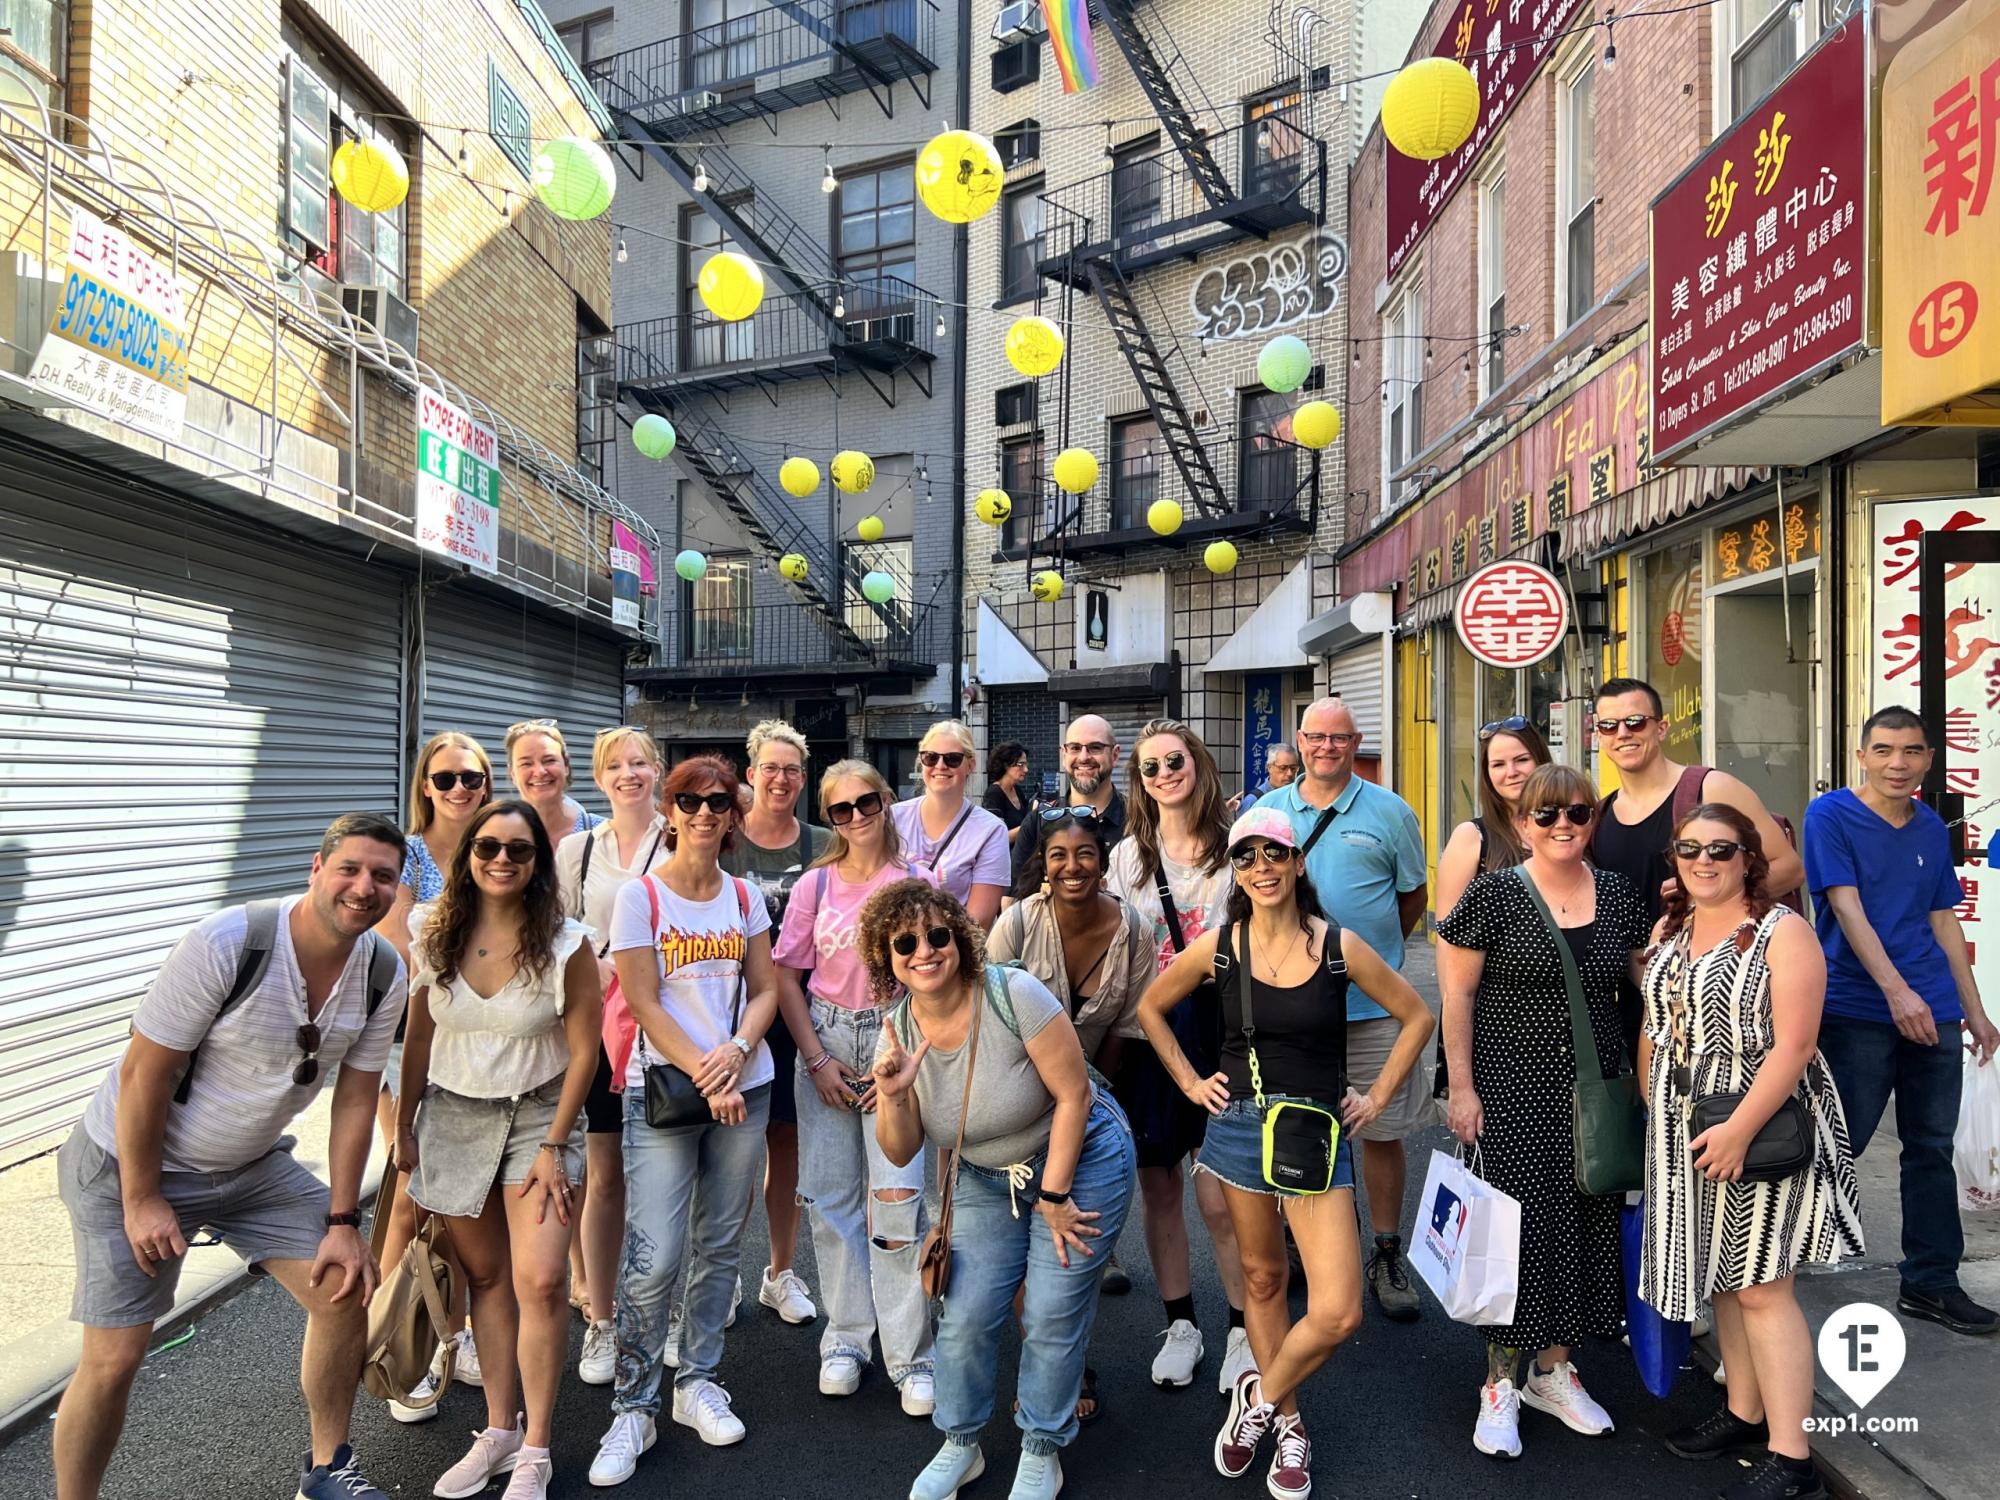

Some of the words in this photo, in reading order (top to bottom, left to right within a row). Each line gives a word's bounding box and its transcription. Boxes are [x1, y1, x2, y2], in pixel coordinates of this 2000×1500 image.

[1705, 111, 1792, 239] 莎莎
[59, 272, 159, 371] 917-297-8029
[1660, 366, 1682, 394] Sasa
[1686, 345, 1723, 380] Cosmetics
[1728, 329, 1736, 351] &
[1739, 317, 1761, 344] Skin
[1765, 302, 1789, 329] Care
[1794, 275, 1827, 308] Beauty
[1833, 257, 1852, 281] Inc.
[1916, 287, 1966, 351] 15
[39, 363, 60, 386] D.H.
[63, 373, 97, 402] Realty
[98, 387, 106, 404] &
[108, 391, 163, 425] Management
[1659, 410, 1666, 433] 13
[1667, 402, 1688, 430] Doyers
[1691, 391, 1700, 414] St.
[1723, 334, 1789, 395] Tel:212-608-0907
[1793, 293, 1852, 353] 212-964-3510
[423, 394, 454, 438] STORE
[456, 416, 473, 450] FOR
[475, 426, 494, 463] RENT
[1553, 404, 1594, 472] Tea
[450, 492, 490, 528] 662-3198
[461, 543, 480, 560] REALTY
[1674, 684, 1702, 724] Wah
